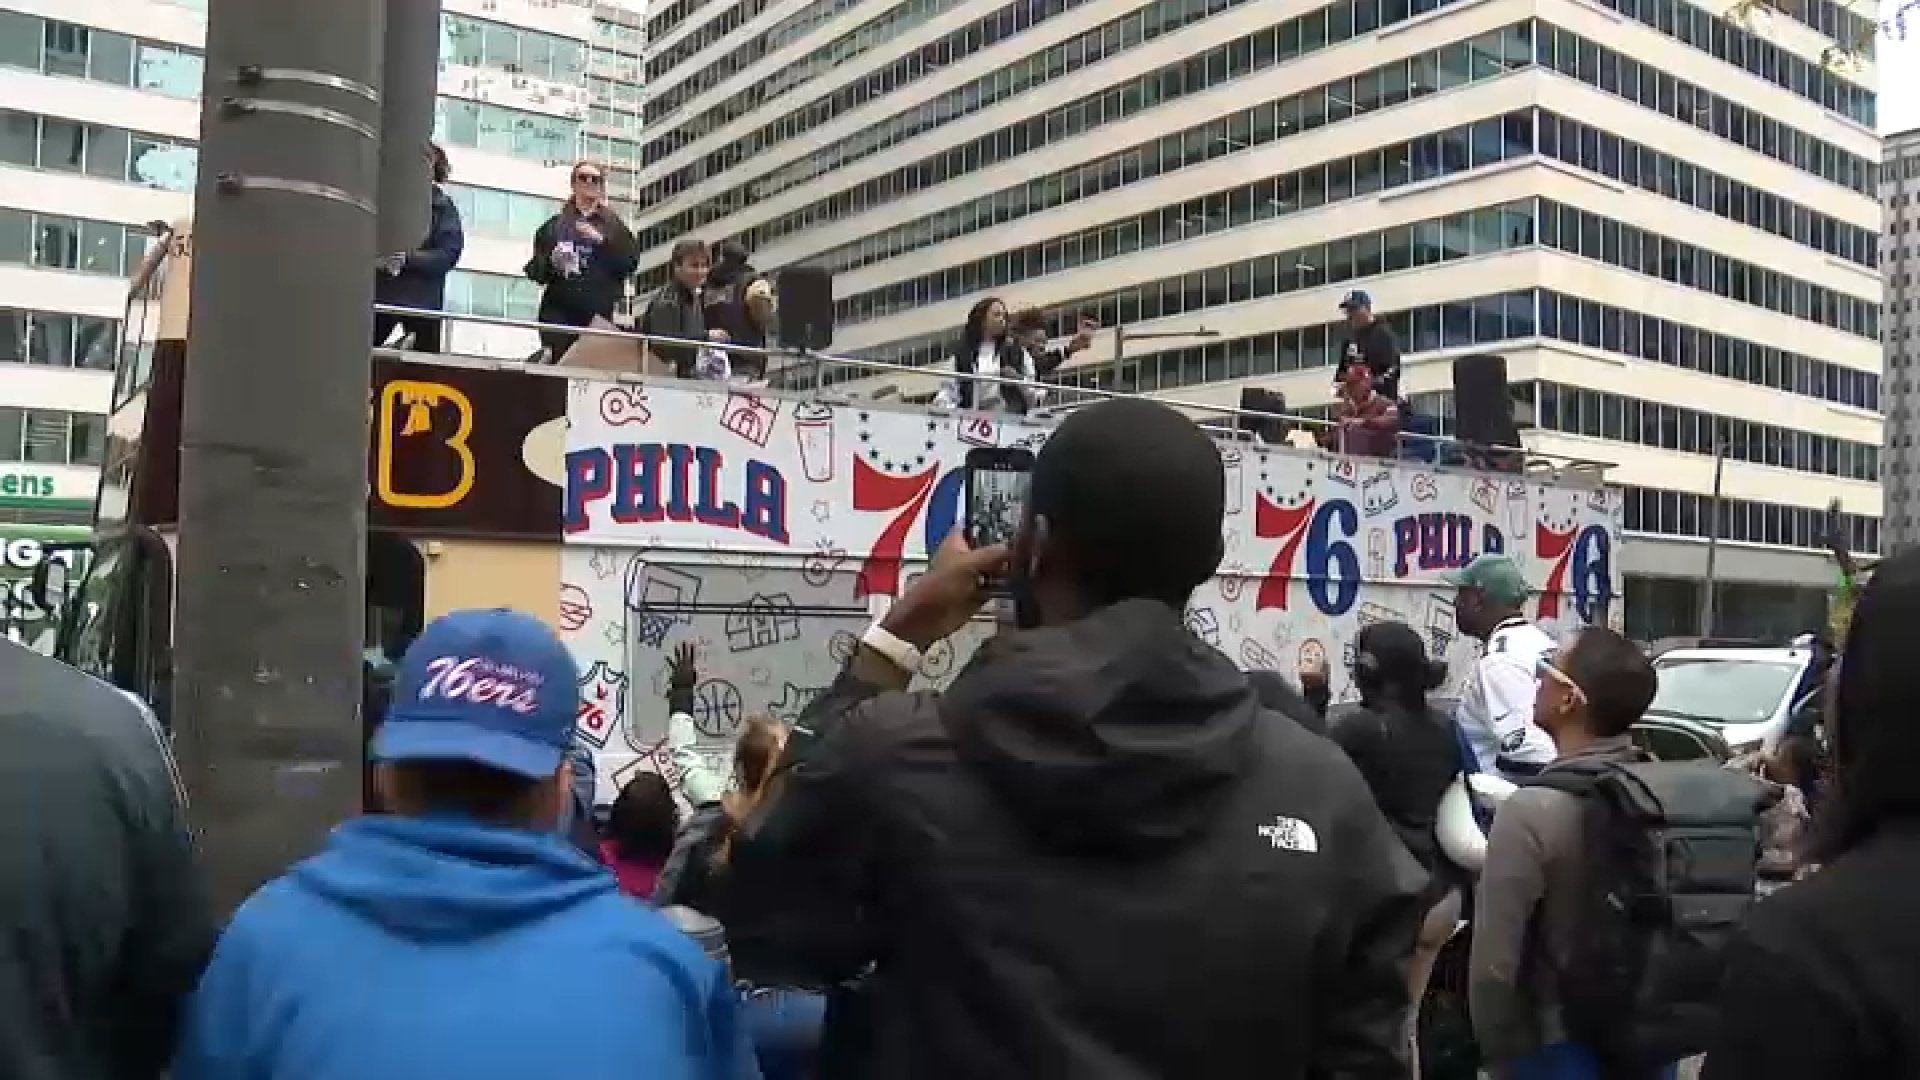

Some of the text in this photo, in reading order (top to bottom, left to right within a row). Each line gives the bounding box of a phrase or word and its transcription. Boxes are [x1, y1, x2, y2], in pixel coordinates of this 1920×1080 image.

[2, 473, 55, 495] ens
[565, 442, 790, 545] PHILA
[1256, 491, 1361, 616] 76
[1536, 522, 1612, 624] 76
[416, 655, 540, 714] 76ers
[575, 701, 604, 731] 76
